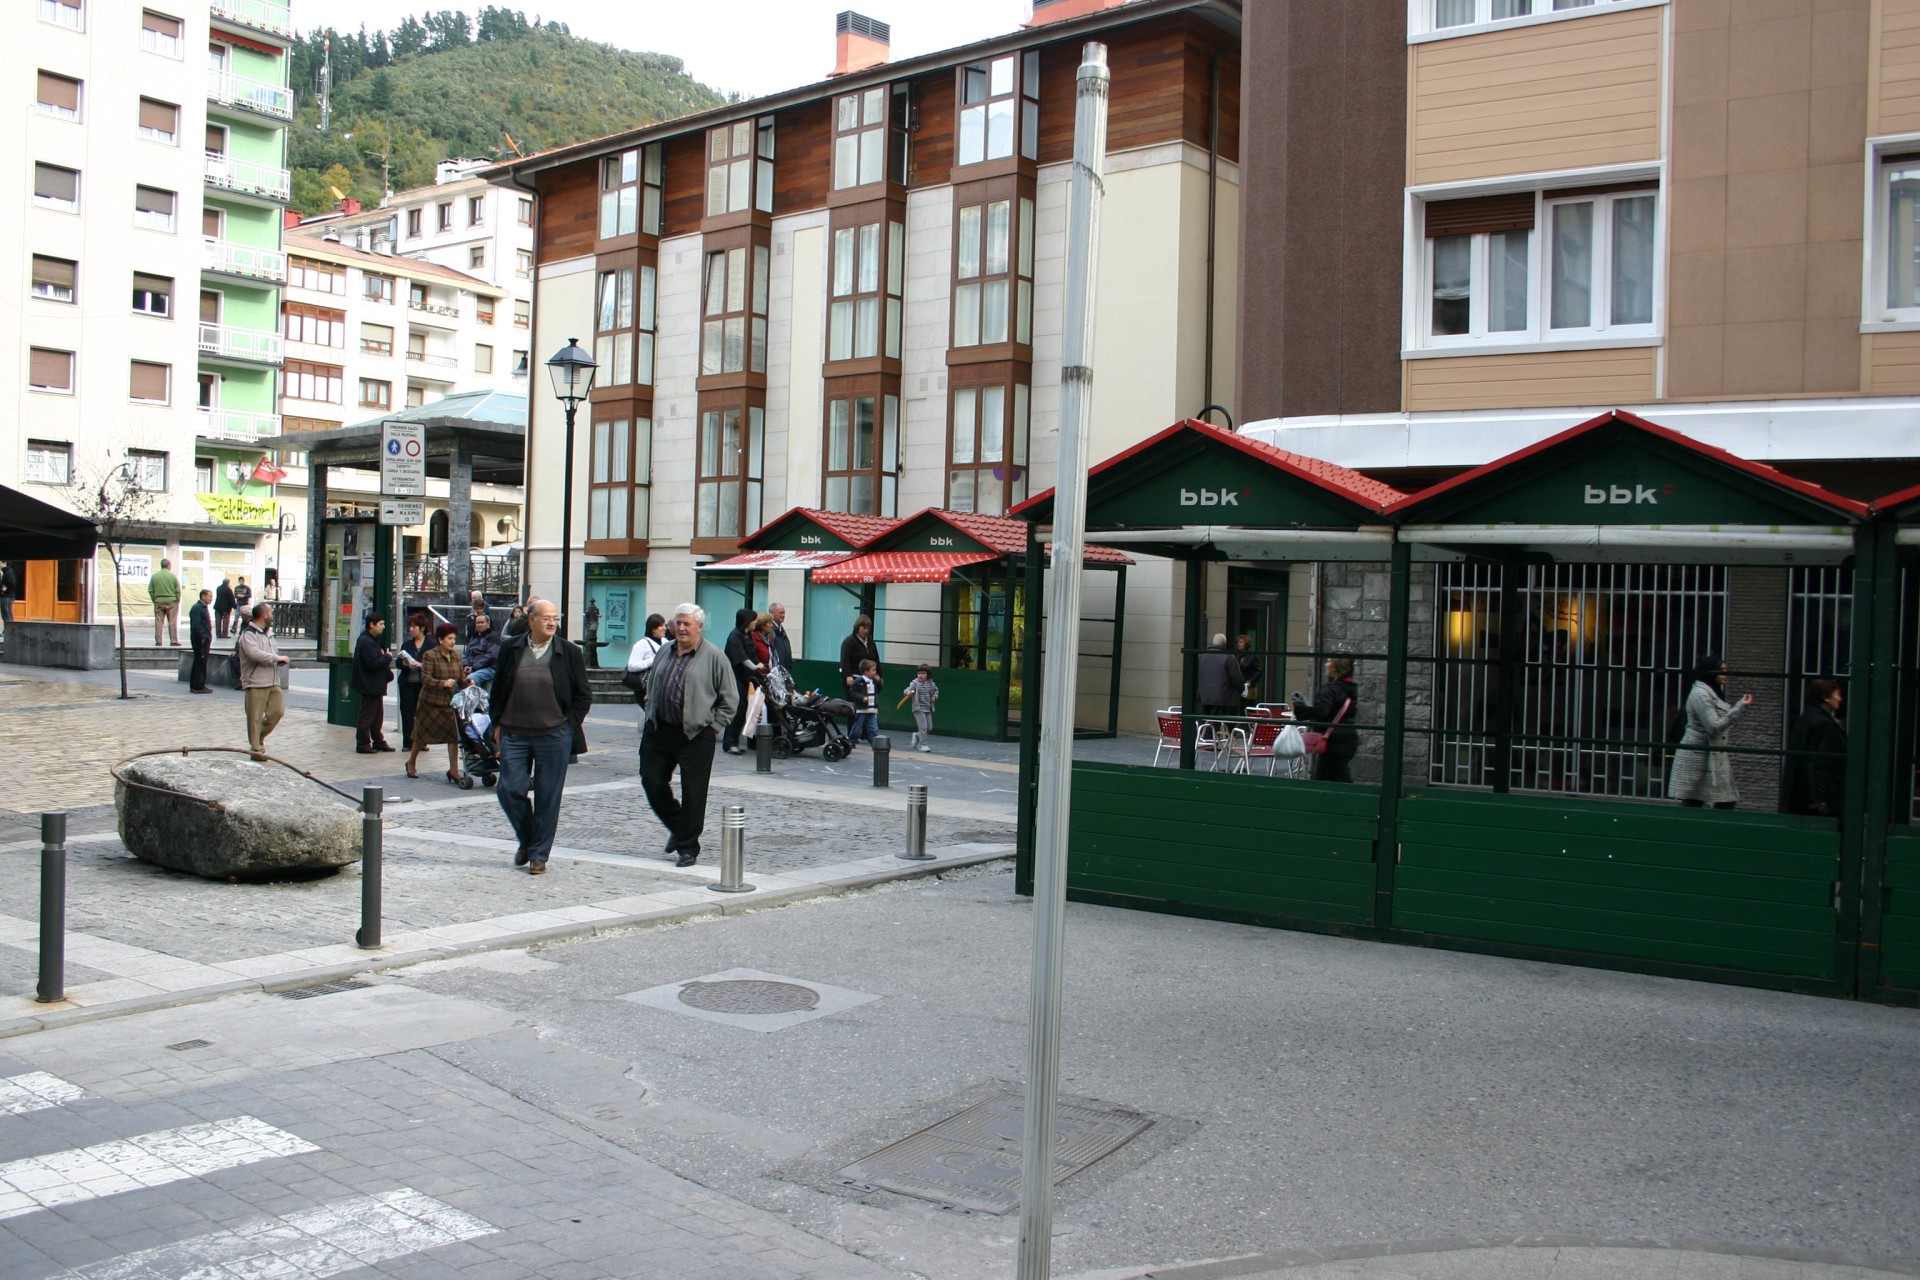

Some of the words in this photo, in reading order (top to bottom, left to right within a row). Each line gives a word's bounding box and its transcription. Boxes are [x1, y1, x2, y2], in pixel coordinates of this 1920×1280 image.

[1180, 488, 1238, 506] bbk
[1584, 484, 1658, 504] bbk
[800, 536, 821, 544] bbk
[930, 537, 953, 546] bbk
